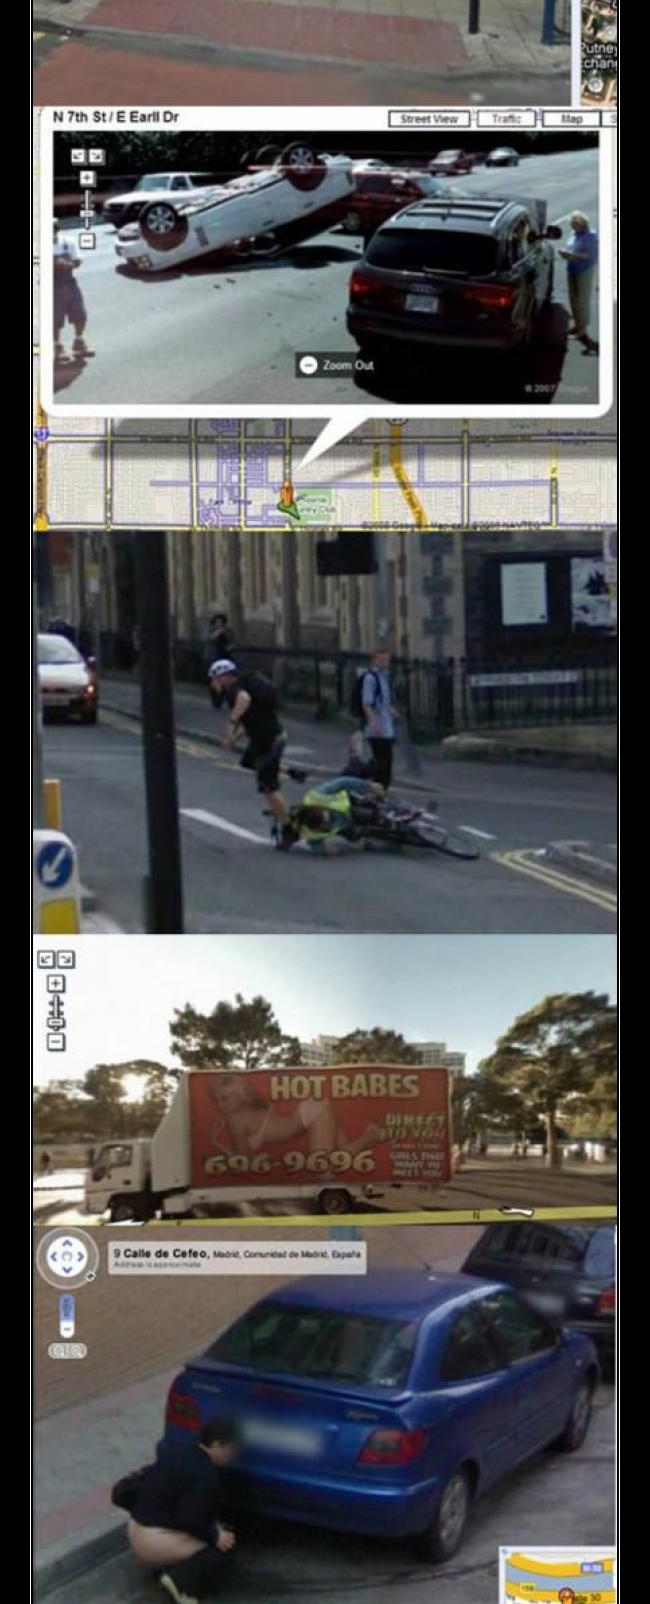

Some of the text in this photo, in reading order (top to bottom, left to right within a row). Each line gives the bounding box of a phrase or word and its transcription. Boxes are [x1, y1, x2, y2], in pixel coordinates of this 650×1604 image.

[53, 110, 64, 123] N
[67, 110, 88, 123] 7th
[93, 110, 107, 123] St
[116, 111, 127, 123] E
[163, 111, 180, 123] Dr
[400, 114, 459, 125] Street View
[492, 114, 522, 125] Traffic
[561, 114, 583, 127] Map
[270, 1073, 420, 1100] HOT BABES
[385, 1113, 446, 1127] DIRECT
[203, 1149, 376, 1175] 696-9696
